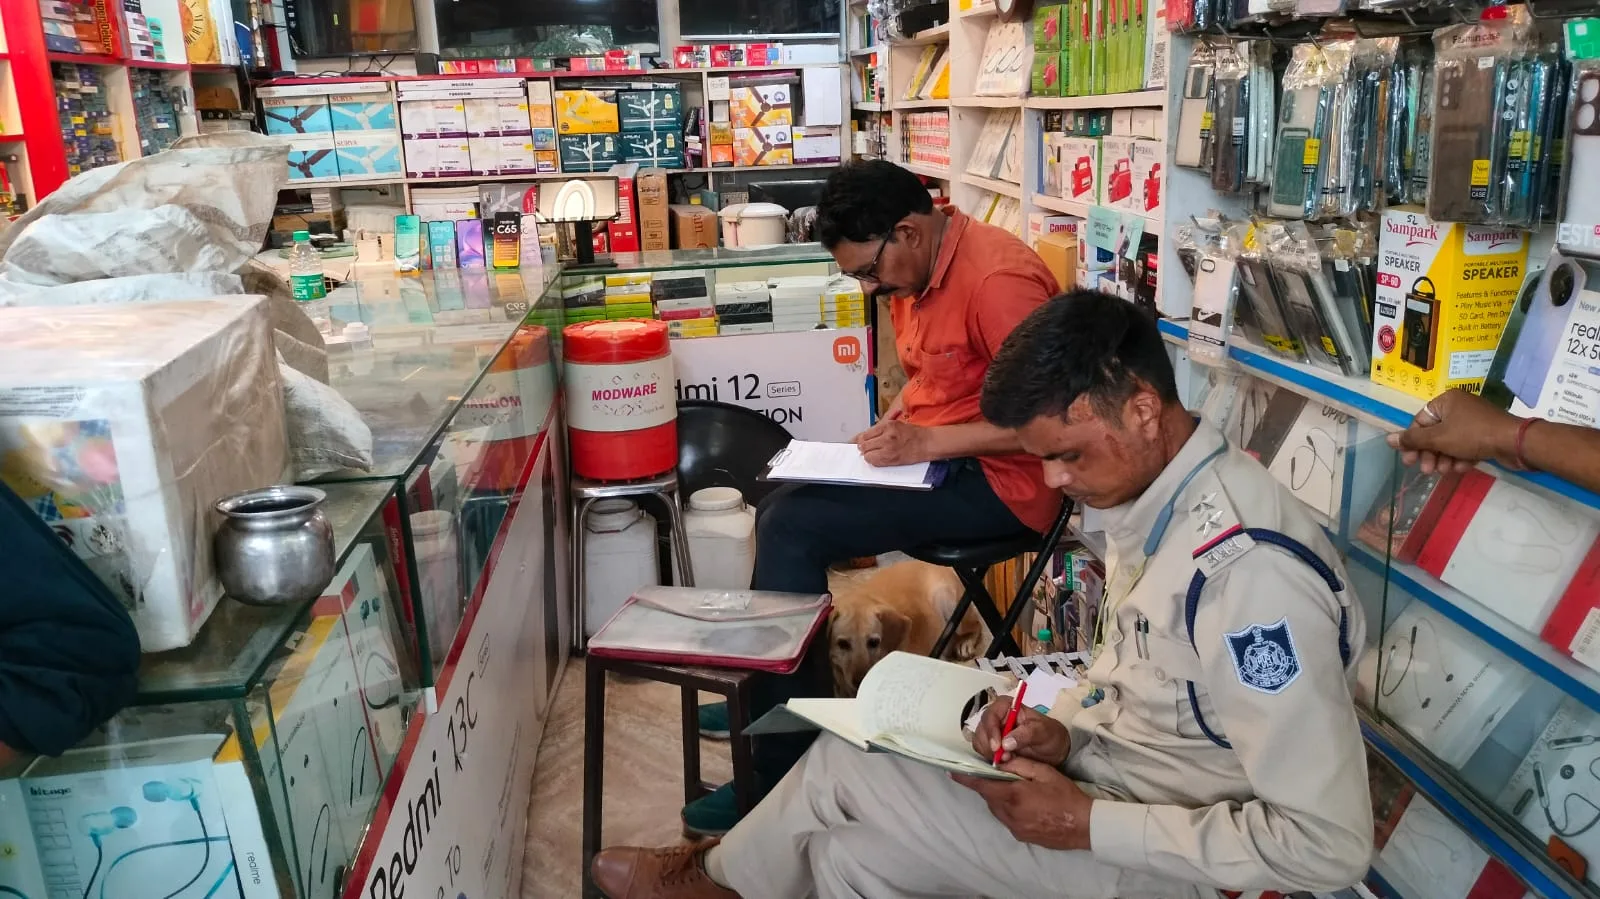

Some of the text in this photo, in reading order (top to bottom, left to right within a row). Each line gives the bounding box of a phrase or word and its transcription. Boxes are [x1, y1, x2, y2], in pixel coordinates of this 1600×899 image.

[497, 225, 517, 234] C65
[1386, 218, 1438, 241] Sampark
[1467, 230, 1518, 244] Sampark
[1384, 256, 1420, 272] SPEAKER
[1381, 274, 1399, 287] SP-60
[1463, 266, 1519, 280] SPEAKER
[1579, 300, 1597, 312] New
[1480, 322, 1501, 330] Battery
[1567, 338, 1588, 357] 12x
[592, 382, 657, 401] MODWARE
[727, 373, 761, 401] 12
[771, 385, 797, 394] Series
[1459, 382, 1480, 392] INDIA
[1322, 405, 1347, 425] OPPO
[245, 851, 261, 885] realme
